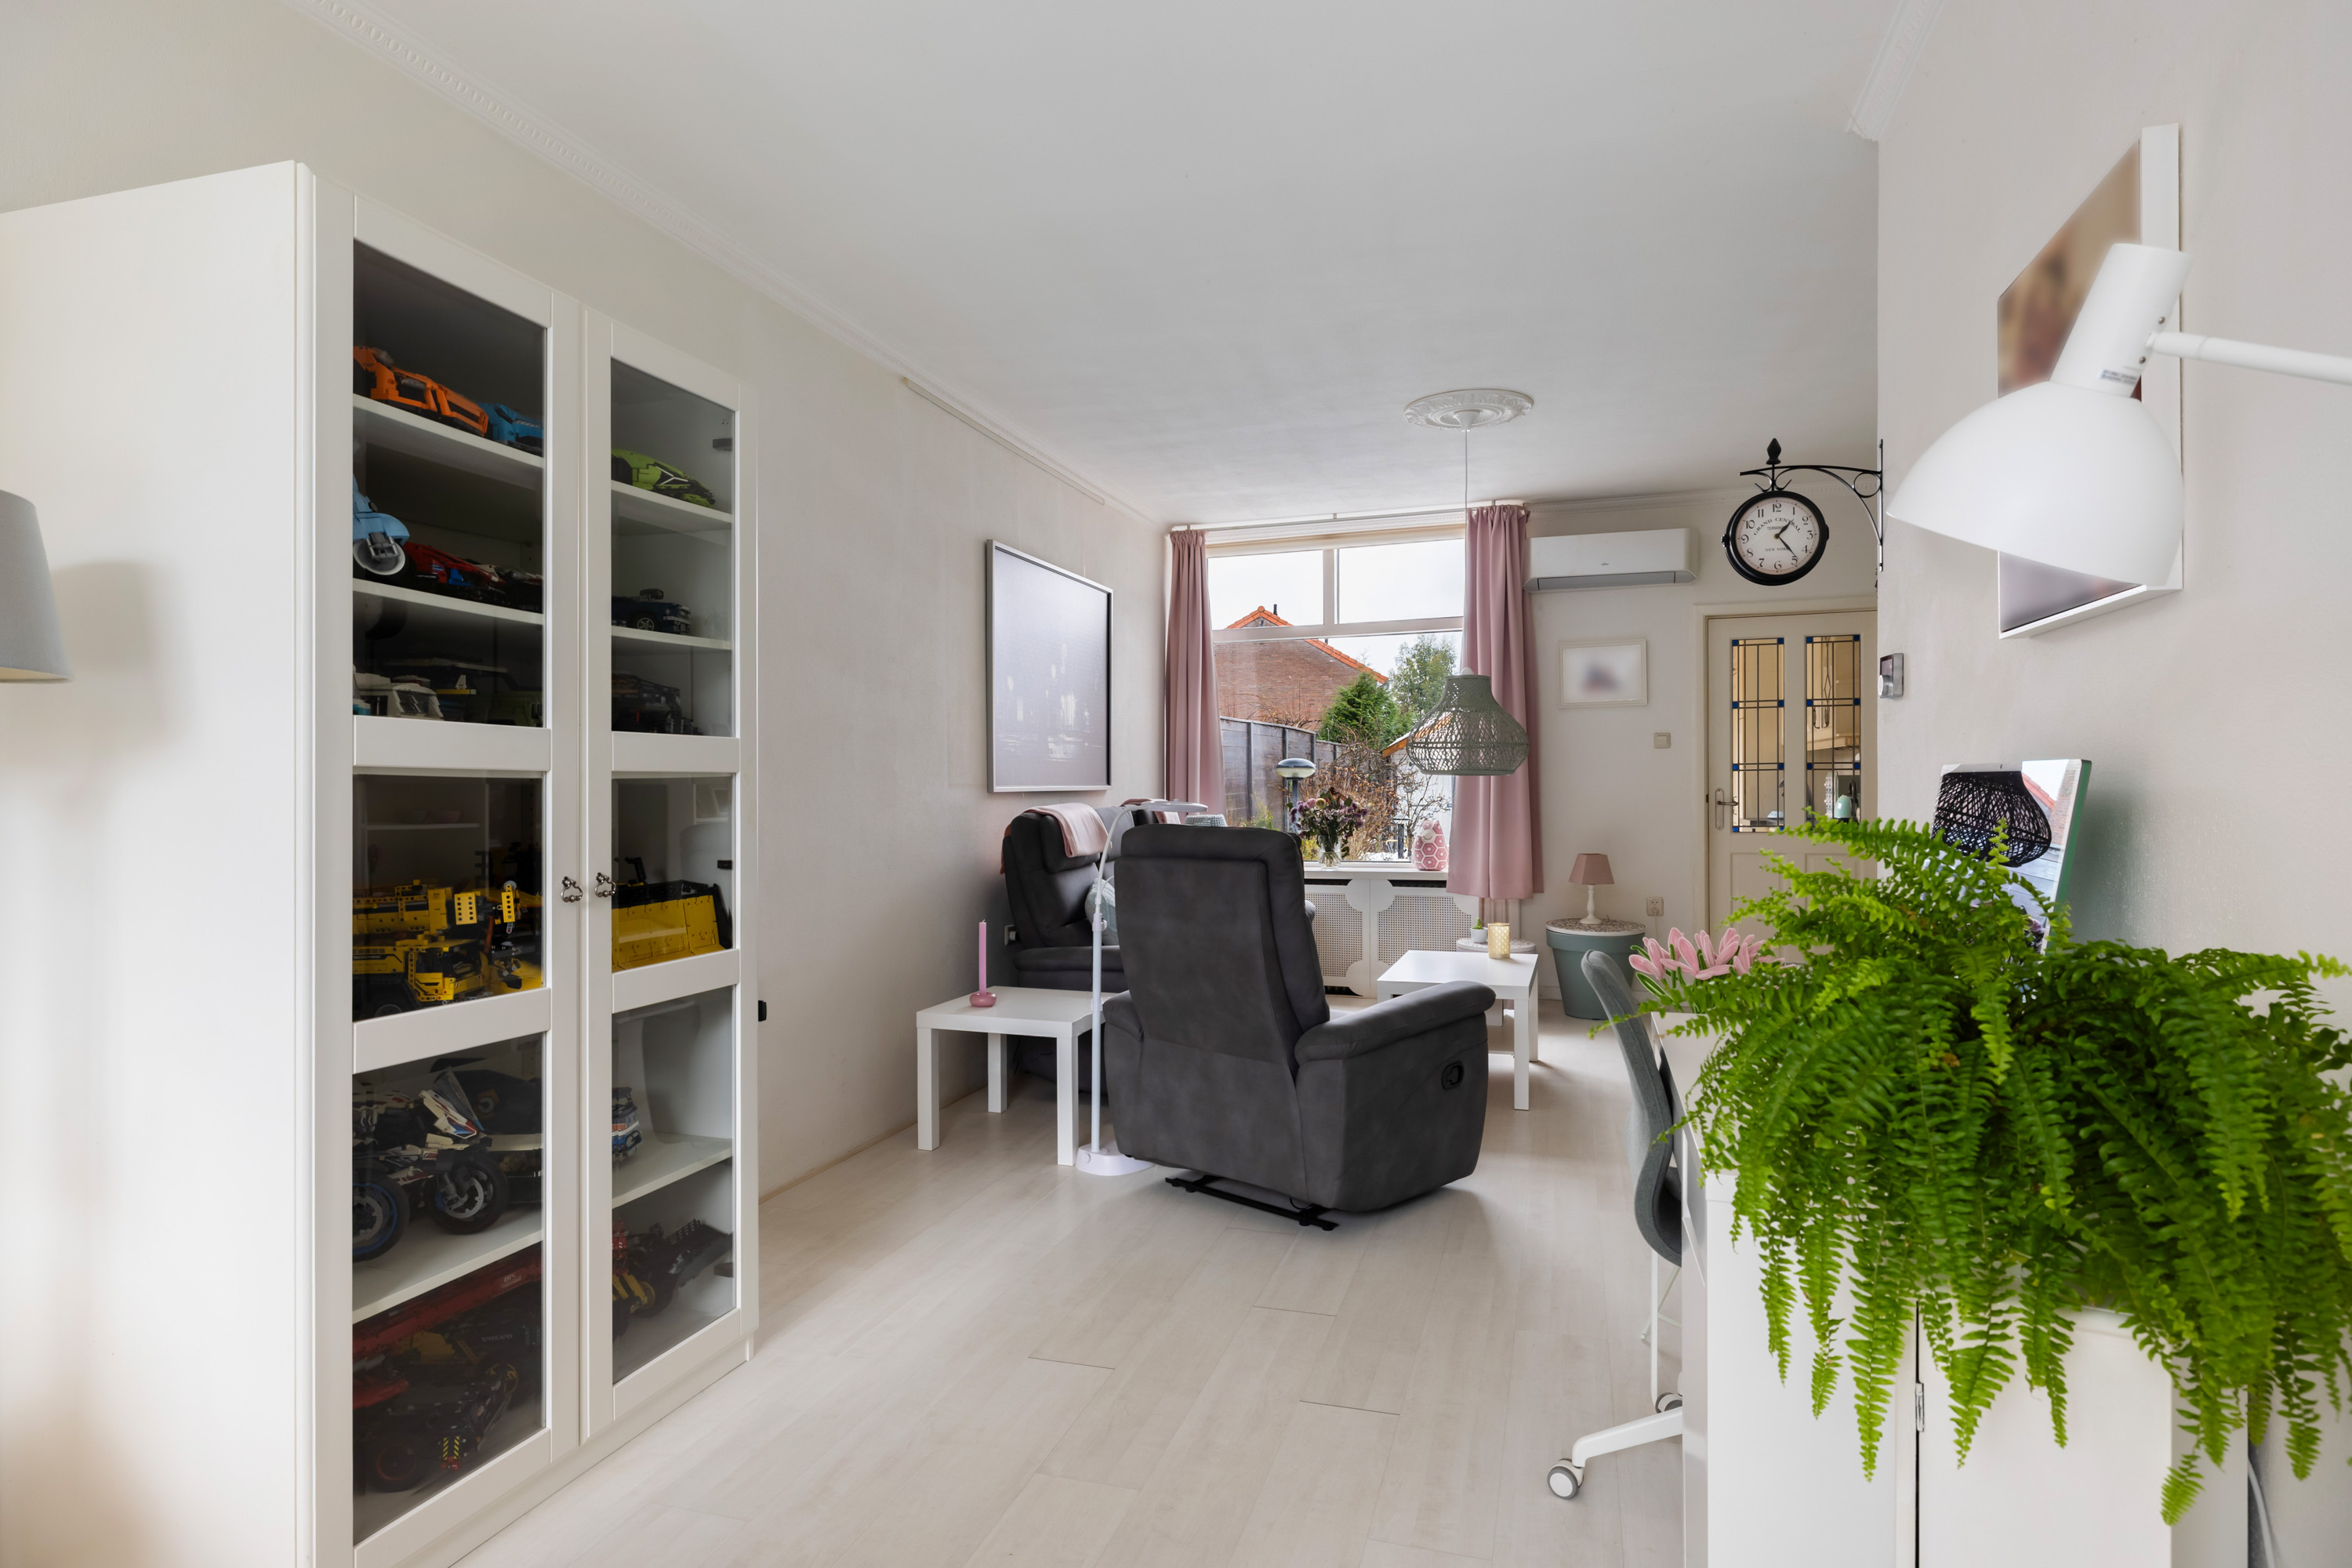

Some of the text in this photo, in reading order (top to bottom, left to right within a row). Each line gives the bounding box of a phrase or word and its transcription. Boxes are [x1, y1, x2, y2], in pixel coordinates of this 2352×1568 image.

[1773, 503, 1782, 513] 12
[1792, 506, 1795, 515] 1
[1758, 509, 1764, 517] 11
[1746, 520, 1755, 529] 10
[1802, 516, 1809, 525] 2
[1754, 517, 1801, 535] GRAND CENTRAL
[1807, 530, 1813, 539] 3
[1741, 535, 1749, 544] 9
[1746, 548, 1753, 557] 8
[1801, 545, 1809, 554] 4
[1759, 558, 1765, 567] 7
[1791, 556, 1798, 565] 5
[1773, 561, 1782, 570] 6
